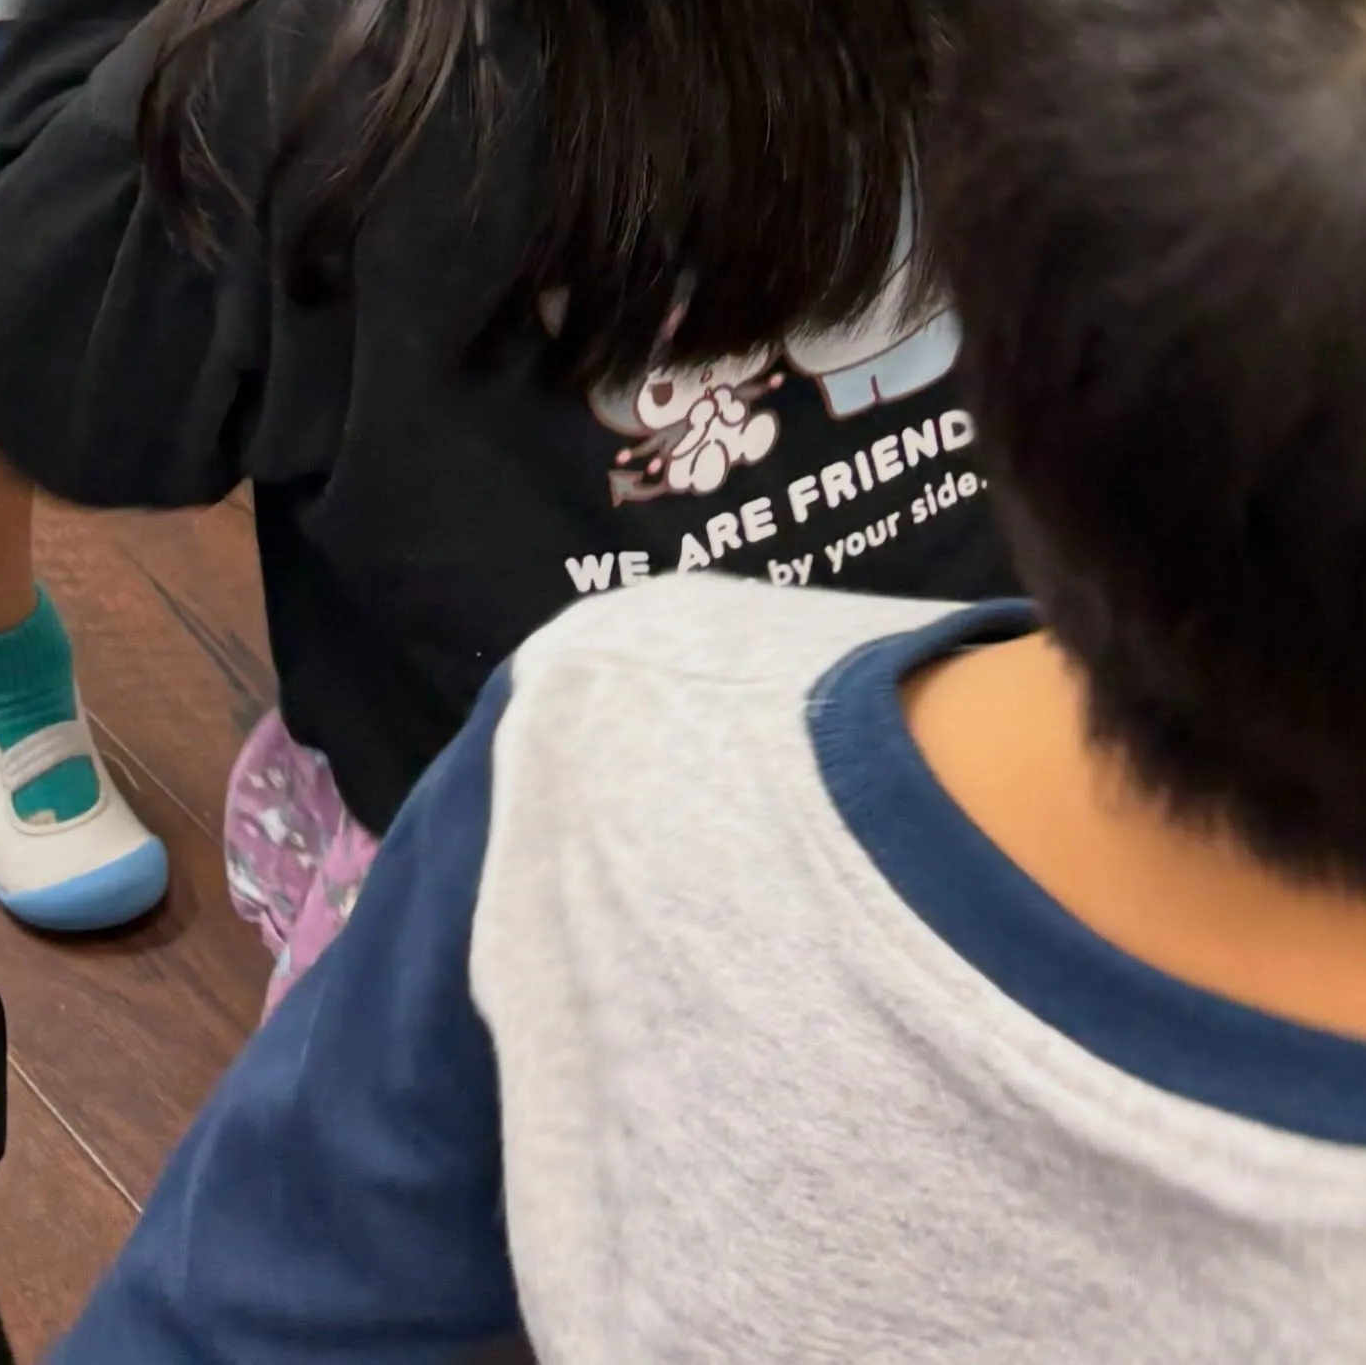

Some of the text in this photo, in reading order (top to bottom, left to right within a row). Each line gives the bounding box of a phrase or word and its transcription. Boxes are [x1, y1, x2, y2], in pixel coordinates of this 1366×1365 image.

[565, 409, 976, 593] WE ARE FRIEND
[767, 471, 988, 587] by your side.
